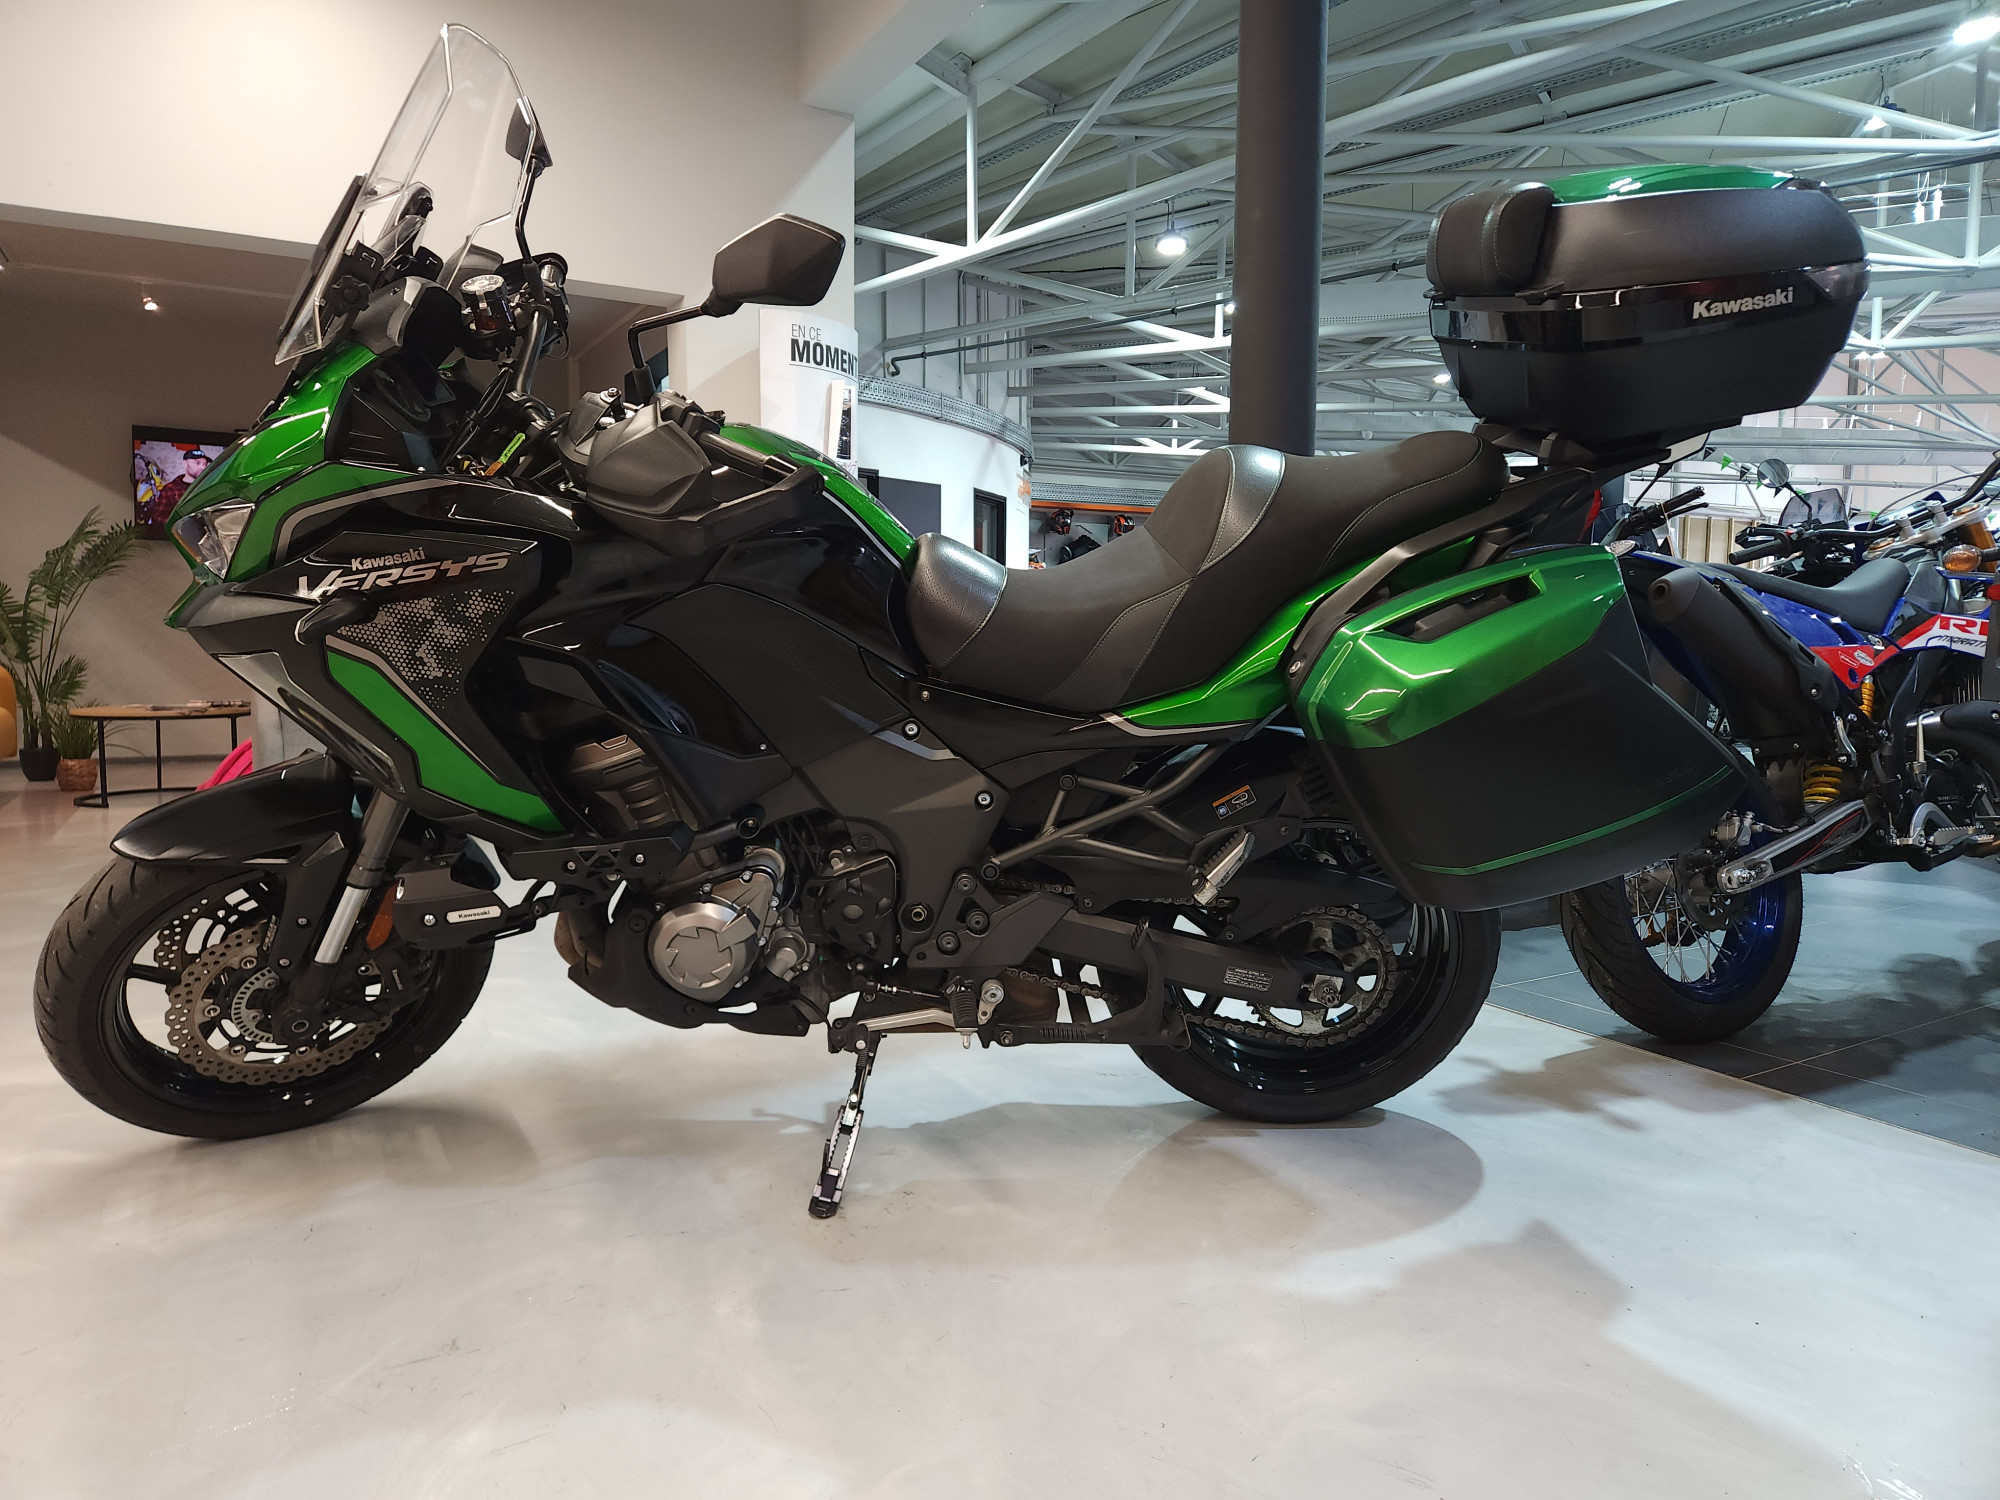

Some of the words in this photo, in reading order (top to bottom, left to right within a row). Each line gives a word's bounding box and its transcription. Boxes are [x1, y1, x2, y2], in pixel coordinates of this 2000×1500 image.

[1692, 286, 1794, 320] Kawasaki
[791, 323, 806, 339] EN
[809, 326, 822, 342] CE
[790, 337, 858, 379] MOMENT
[351, 546, 426, 572] Kawasaki
[298, 552, 512, 599] VERSYS
[458, 909, 491, 920] Kawasaki
